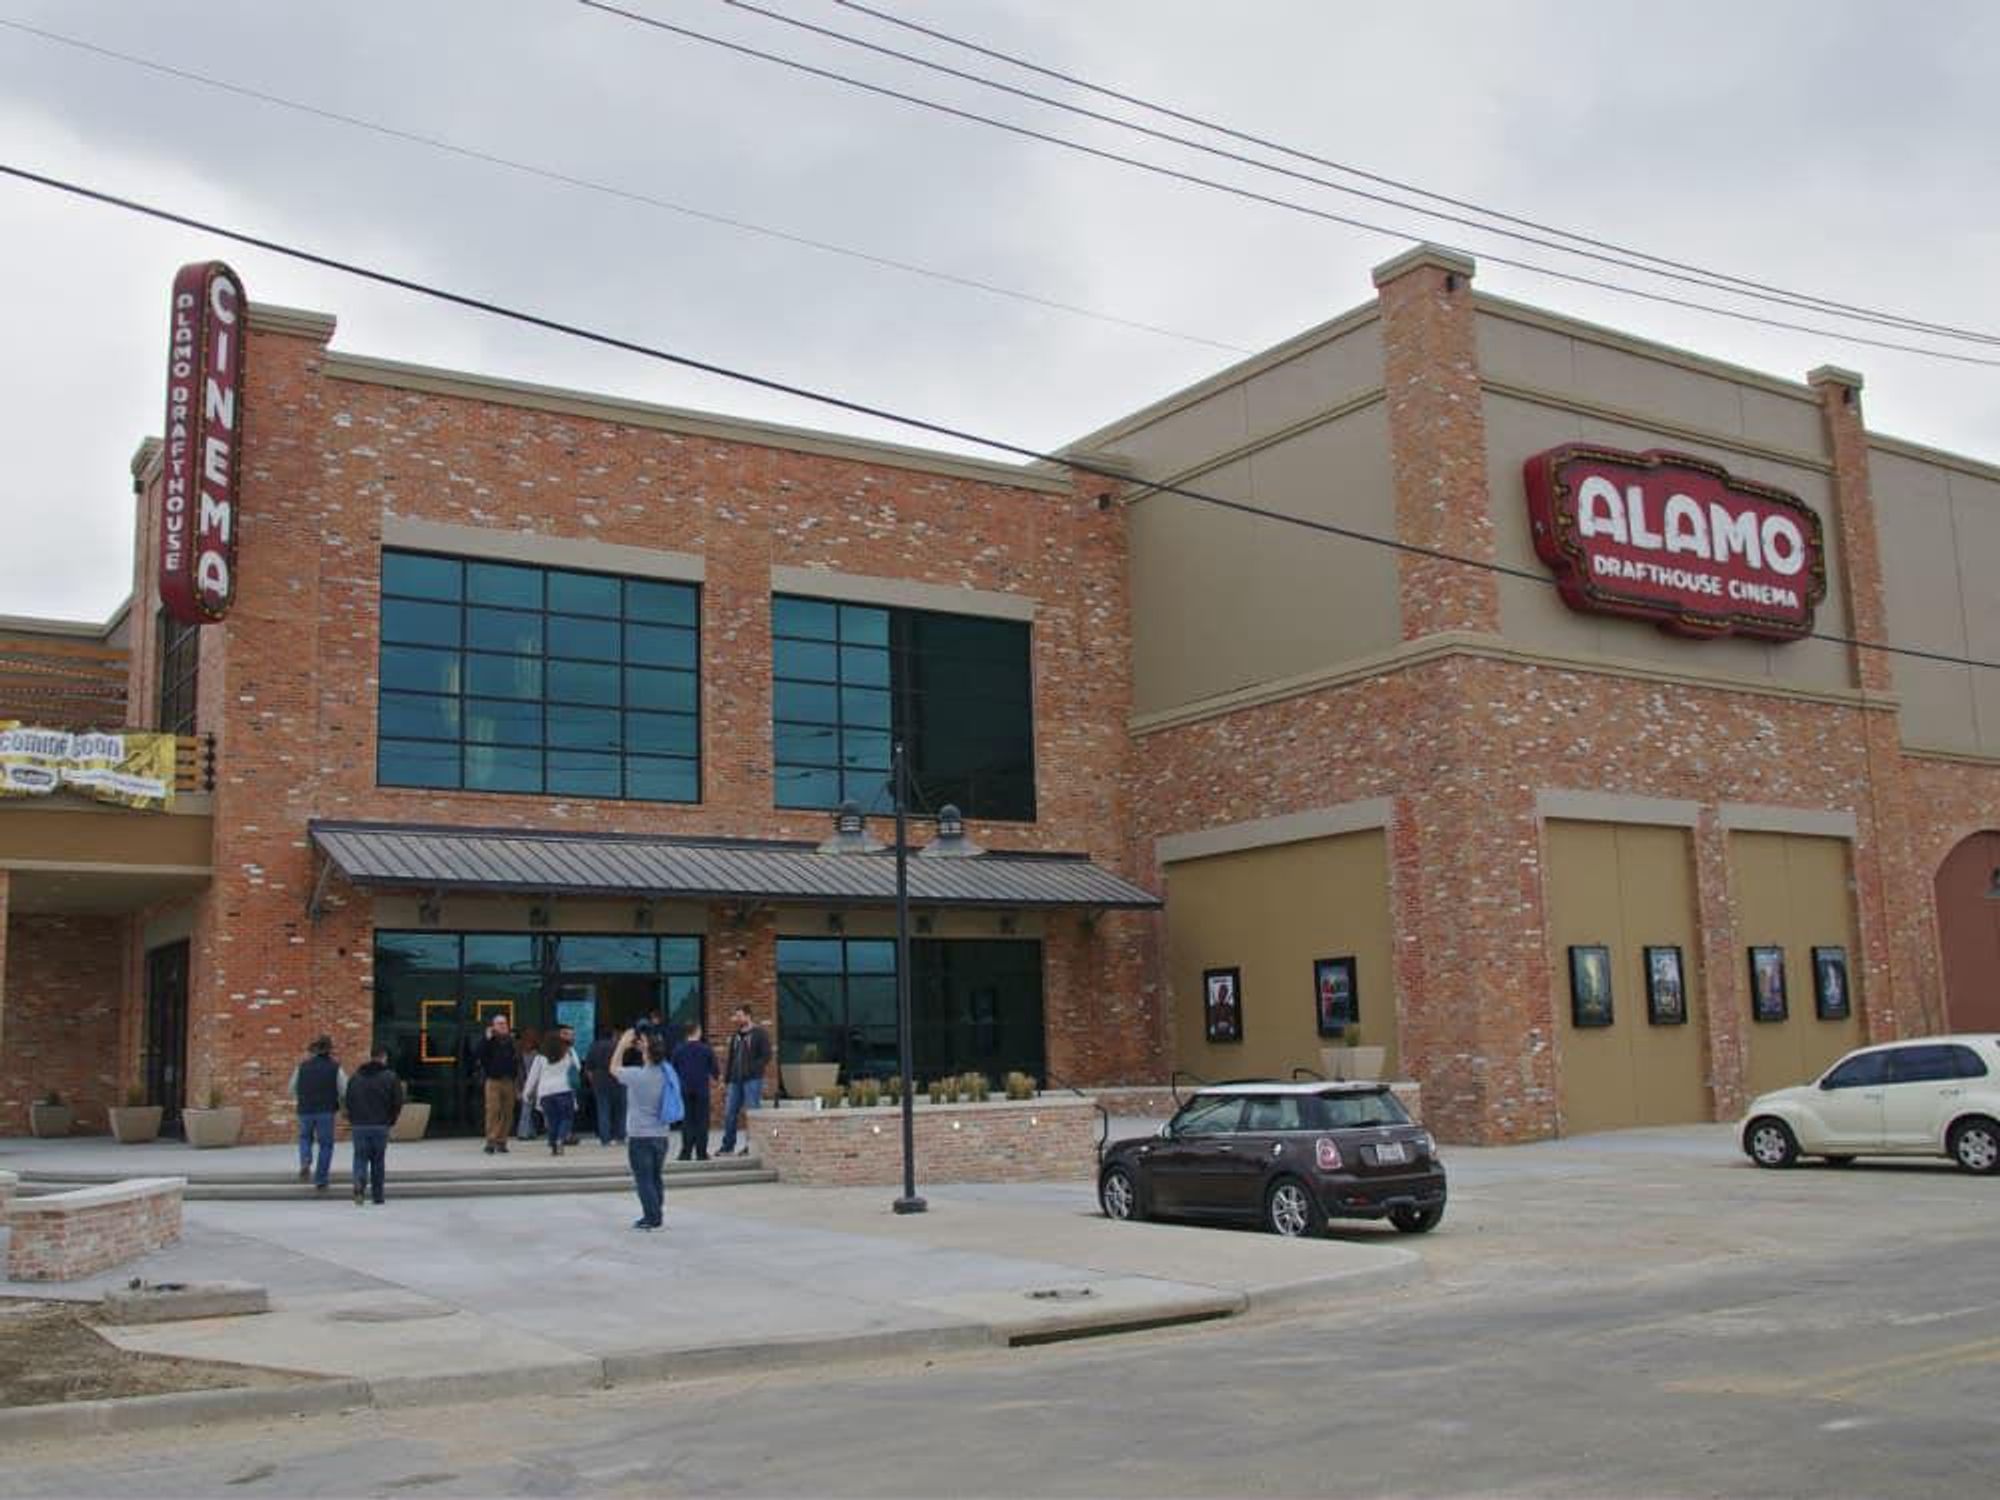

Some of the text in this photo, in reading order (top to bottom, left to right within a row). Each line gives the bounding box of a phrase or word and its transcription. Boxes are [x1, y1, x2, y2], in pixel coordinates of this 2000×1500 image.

[165, 293, 194, 571] ALAMO DRAFTHOUSE
[197, 275, 236, 596] CINEMA
[1577, 475, 1805, 576] ALAMO
[1593, 554, 1799, 609] DRAFTHOUSE CINEMA
